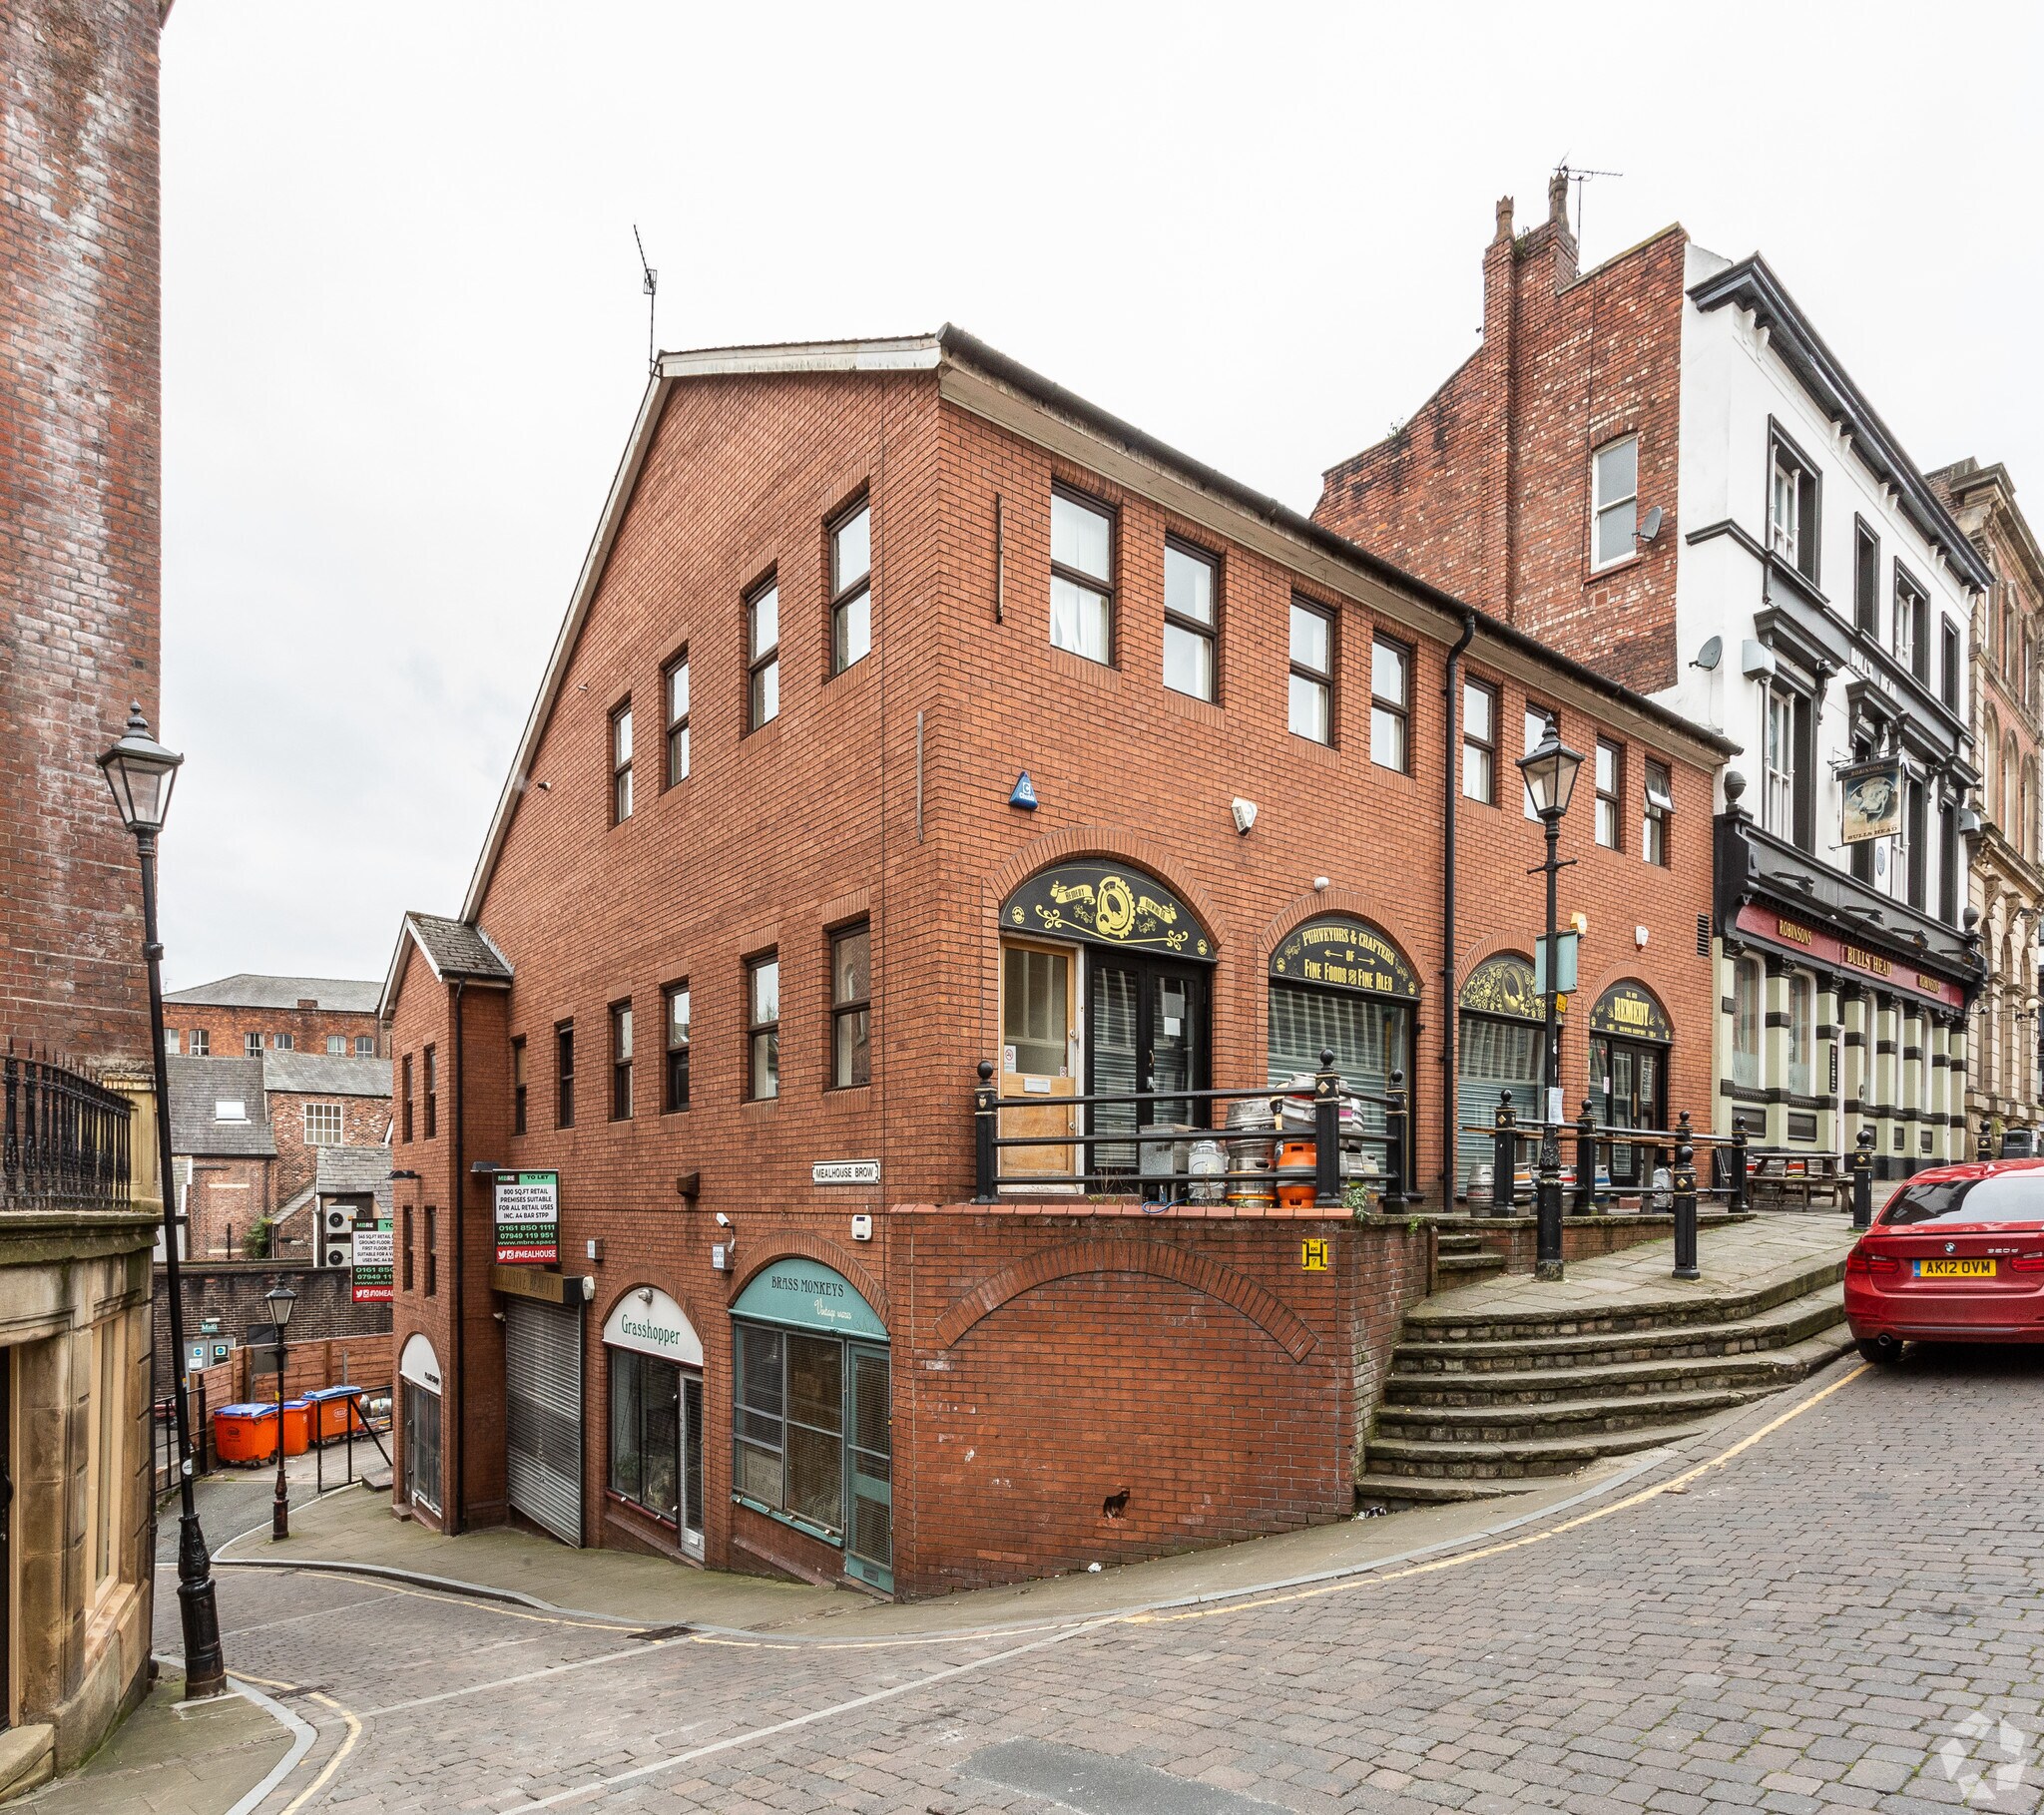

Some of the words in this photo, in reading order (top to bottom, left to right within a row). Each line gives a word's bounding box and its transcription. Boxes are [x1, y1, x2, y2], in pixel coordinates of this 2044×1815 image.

[1851, 764, 1884, 776] ROBINSONS
[1848, 831, 1873, 840] BULLS
[1874, 826, 1897, 835] HEAD
[1779, 919, 1812, 945] ROBINSONS
[1302, 927, 1349, 946] PURVEYORS
[1350, 930, 1357, 945] &
[1359, 932, 1395, 965] CRAFTERS
[1346, 950, 1355, 962] OF
[1847, 946, 1870, 968] BULLS
[1873, 956, 1892, 976] HEAD
[1304, 958, 1322, 980] FINE
[1324, 962, 1347, 984] FOODS
[1358, 968, 1374, 988] FINE
[1376, 972, 1393, 992] ALES
[1919, 973, 1941, 994] ROBINSONS
[1614, 996, 1649, 1026] REMEDY
[816, 1167, 852, 1178] MEALHOUSE
[855, 1167, 873, 1177] BROW
[1307, 1243, 1323, 1266] H
[1926, 1261, 1957, 1274] AK12
[1961, 1261, 1991, 1273] OVM
[771, 1276, 799, 1291] BRASS
[801, 1279, 844, 1297] MONKEYS
[621, 1314, 680, 1346] Grasshopper
